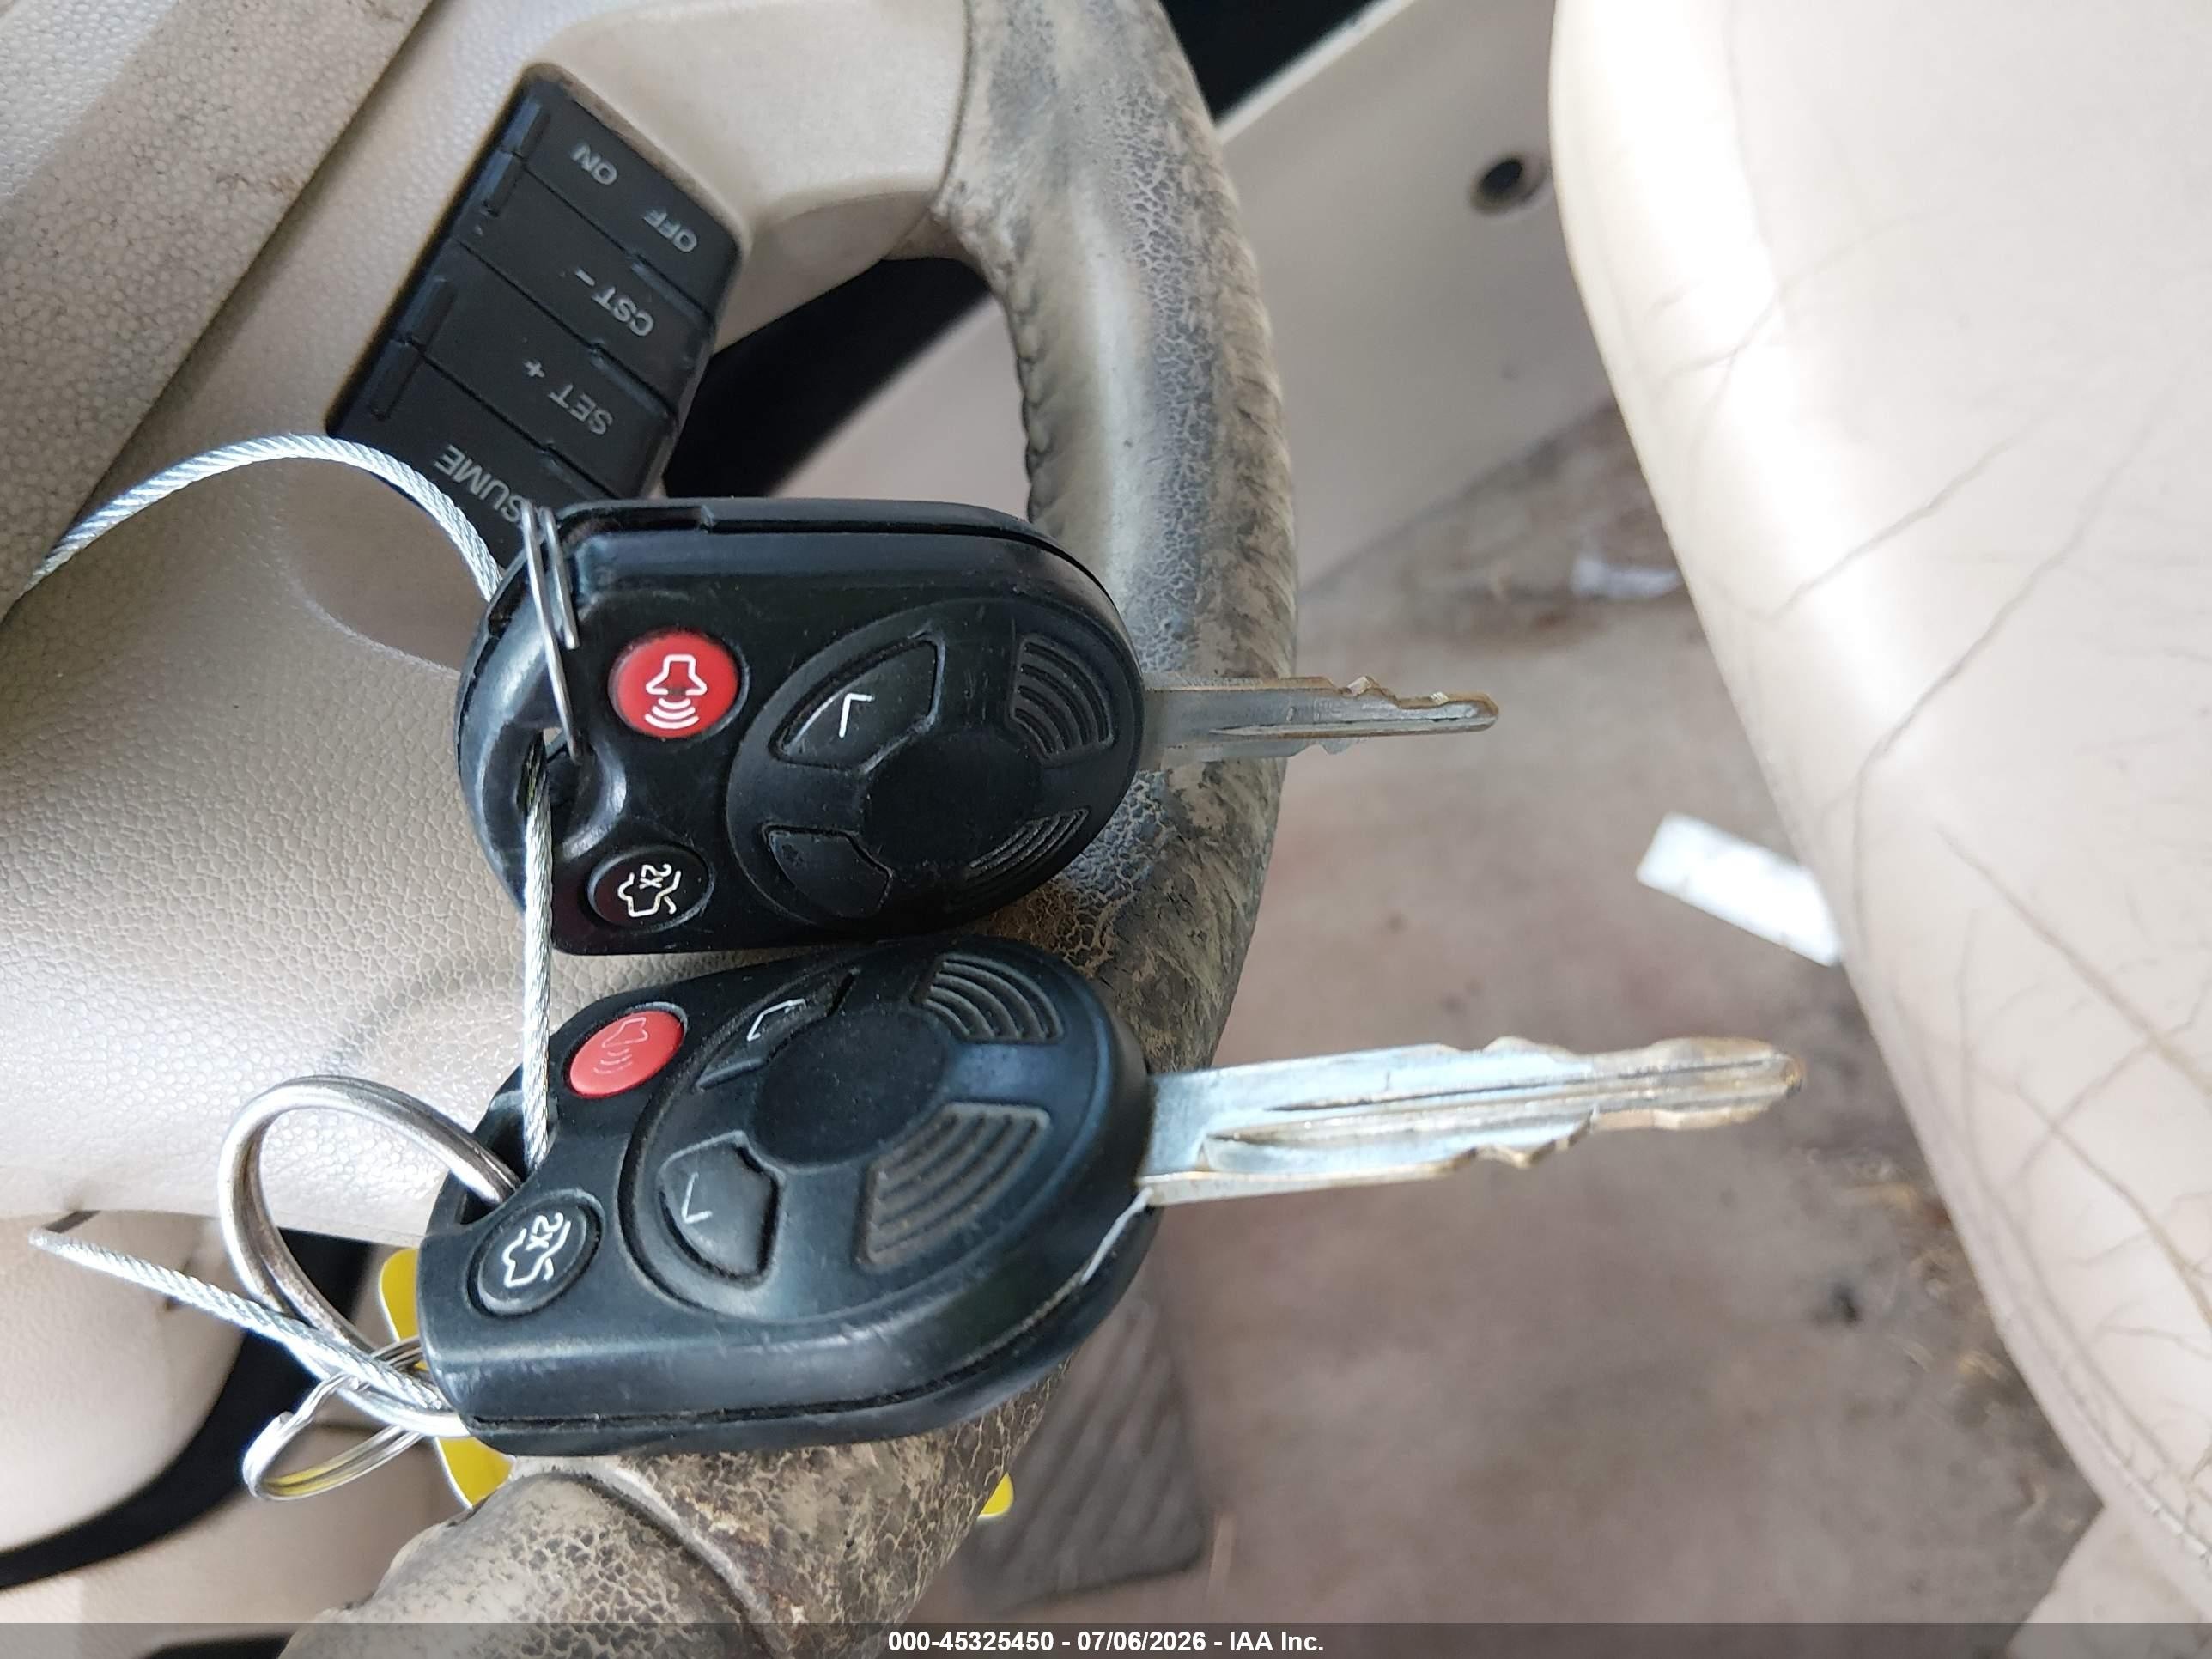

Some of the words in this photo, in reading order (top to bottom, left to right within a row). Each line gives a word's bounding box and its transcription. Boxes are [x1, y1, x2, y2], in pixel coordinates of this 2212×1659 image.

[571, 144, 617, 185] ON
[641, 209, 698, 253] OFF
[592, 286, 654, 336] CST
[549, 385, 612, 435] SET
[434, 445, 525, 522] SUME
